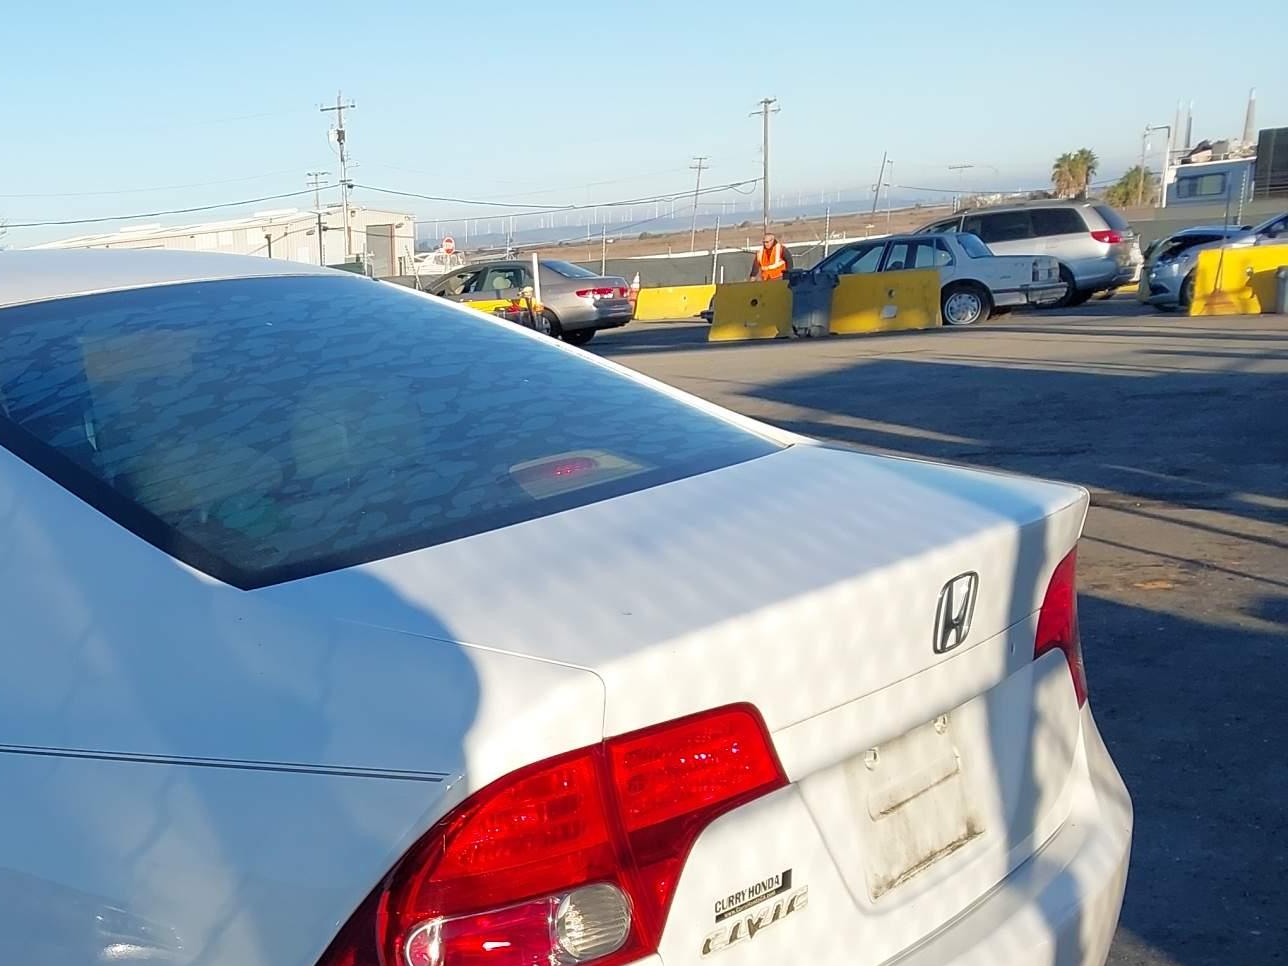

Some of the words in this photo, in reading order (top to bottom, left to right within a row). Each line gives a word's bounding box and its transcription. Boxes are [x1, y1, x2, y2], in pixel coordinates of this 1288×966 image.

[701, 884, 810, 957] CIVIC
[714, 888, 748, 913] CURRY
[748, 874, 780, 898] HONDA
